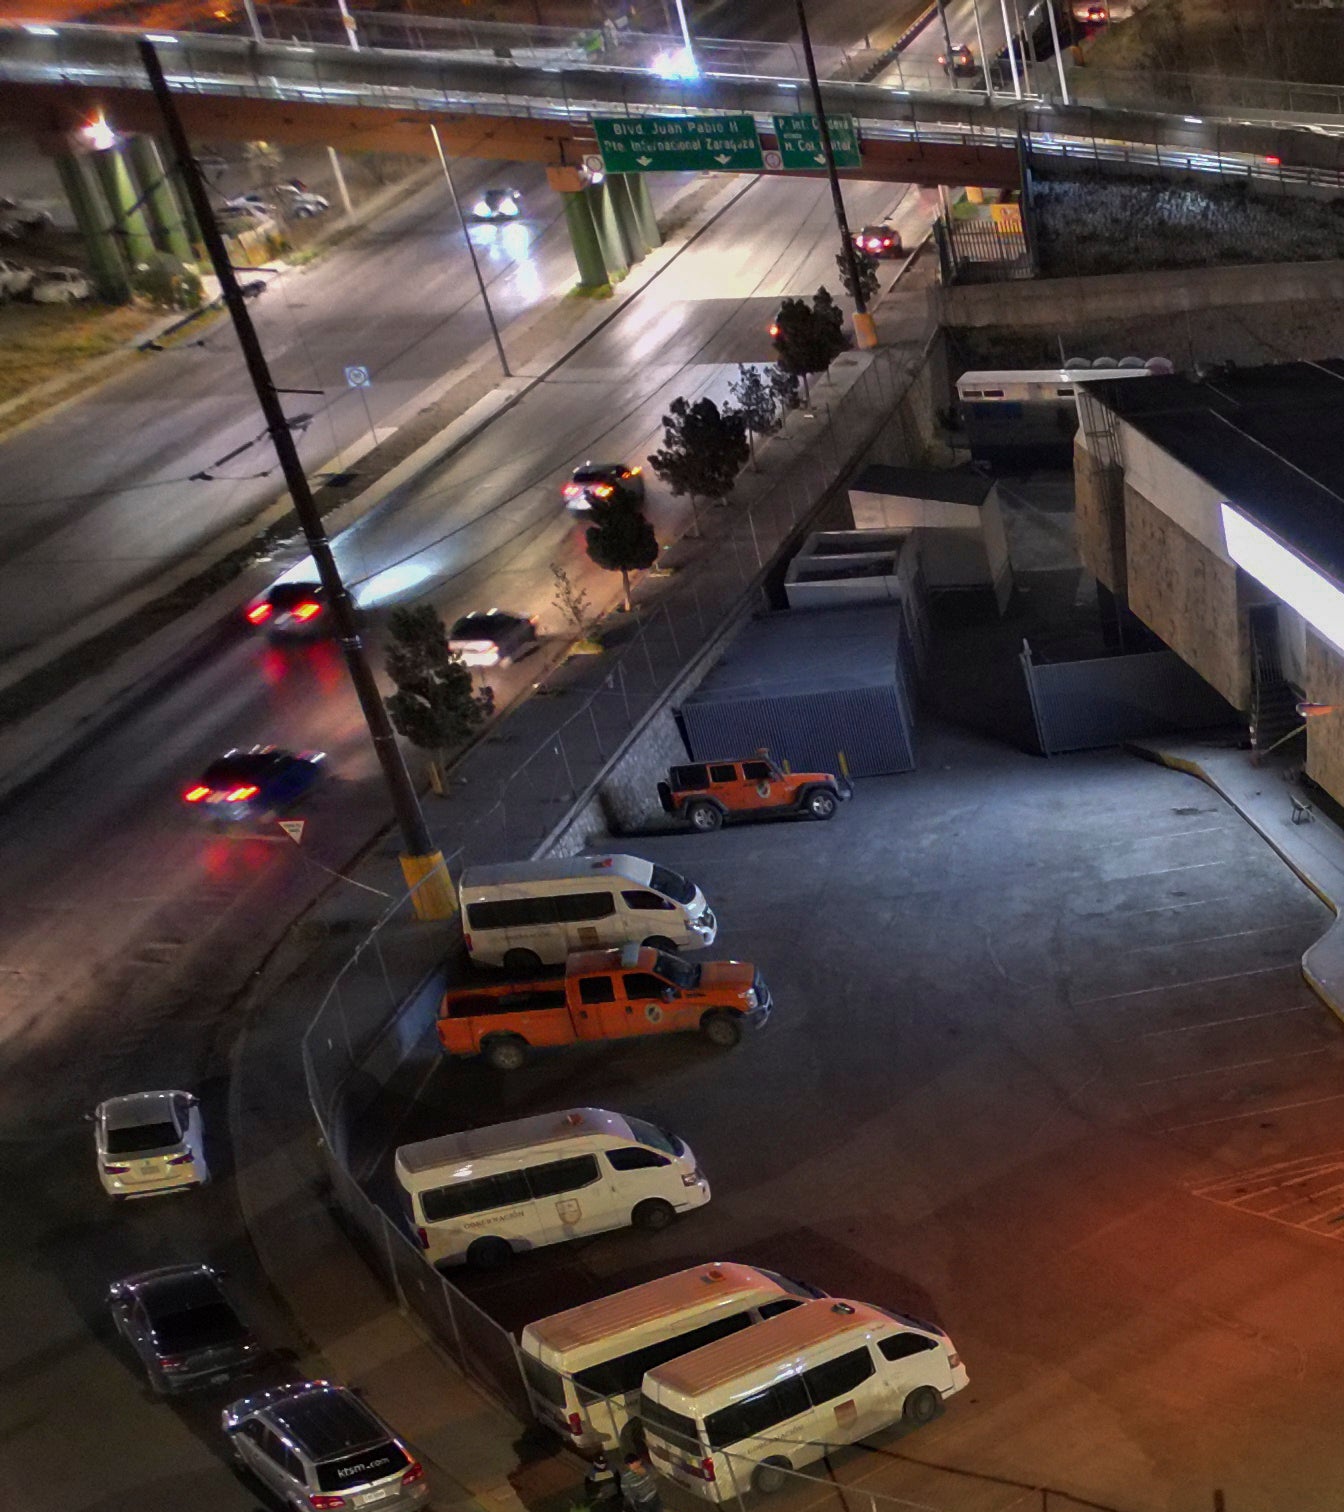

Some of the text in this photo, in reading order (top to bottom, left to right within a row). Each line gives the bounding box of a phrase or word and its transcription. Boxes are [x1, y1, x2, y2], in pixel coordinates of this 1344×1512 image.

[651, 121, 682, 135] Juan
[687, 120, 724, 134] Pablo
[705, 138, 755, 152] Zaragoza
[337, 1457, 390, 1478] ktsm.com
